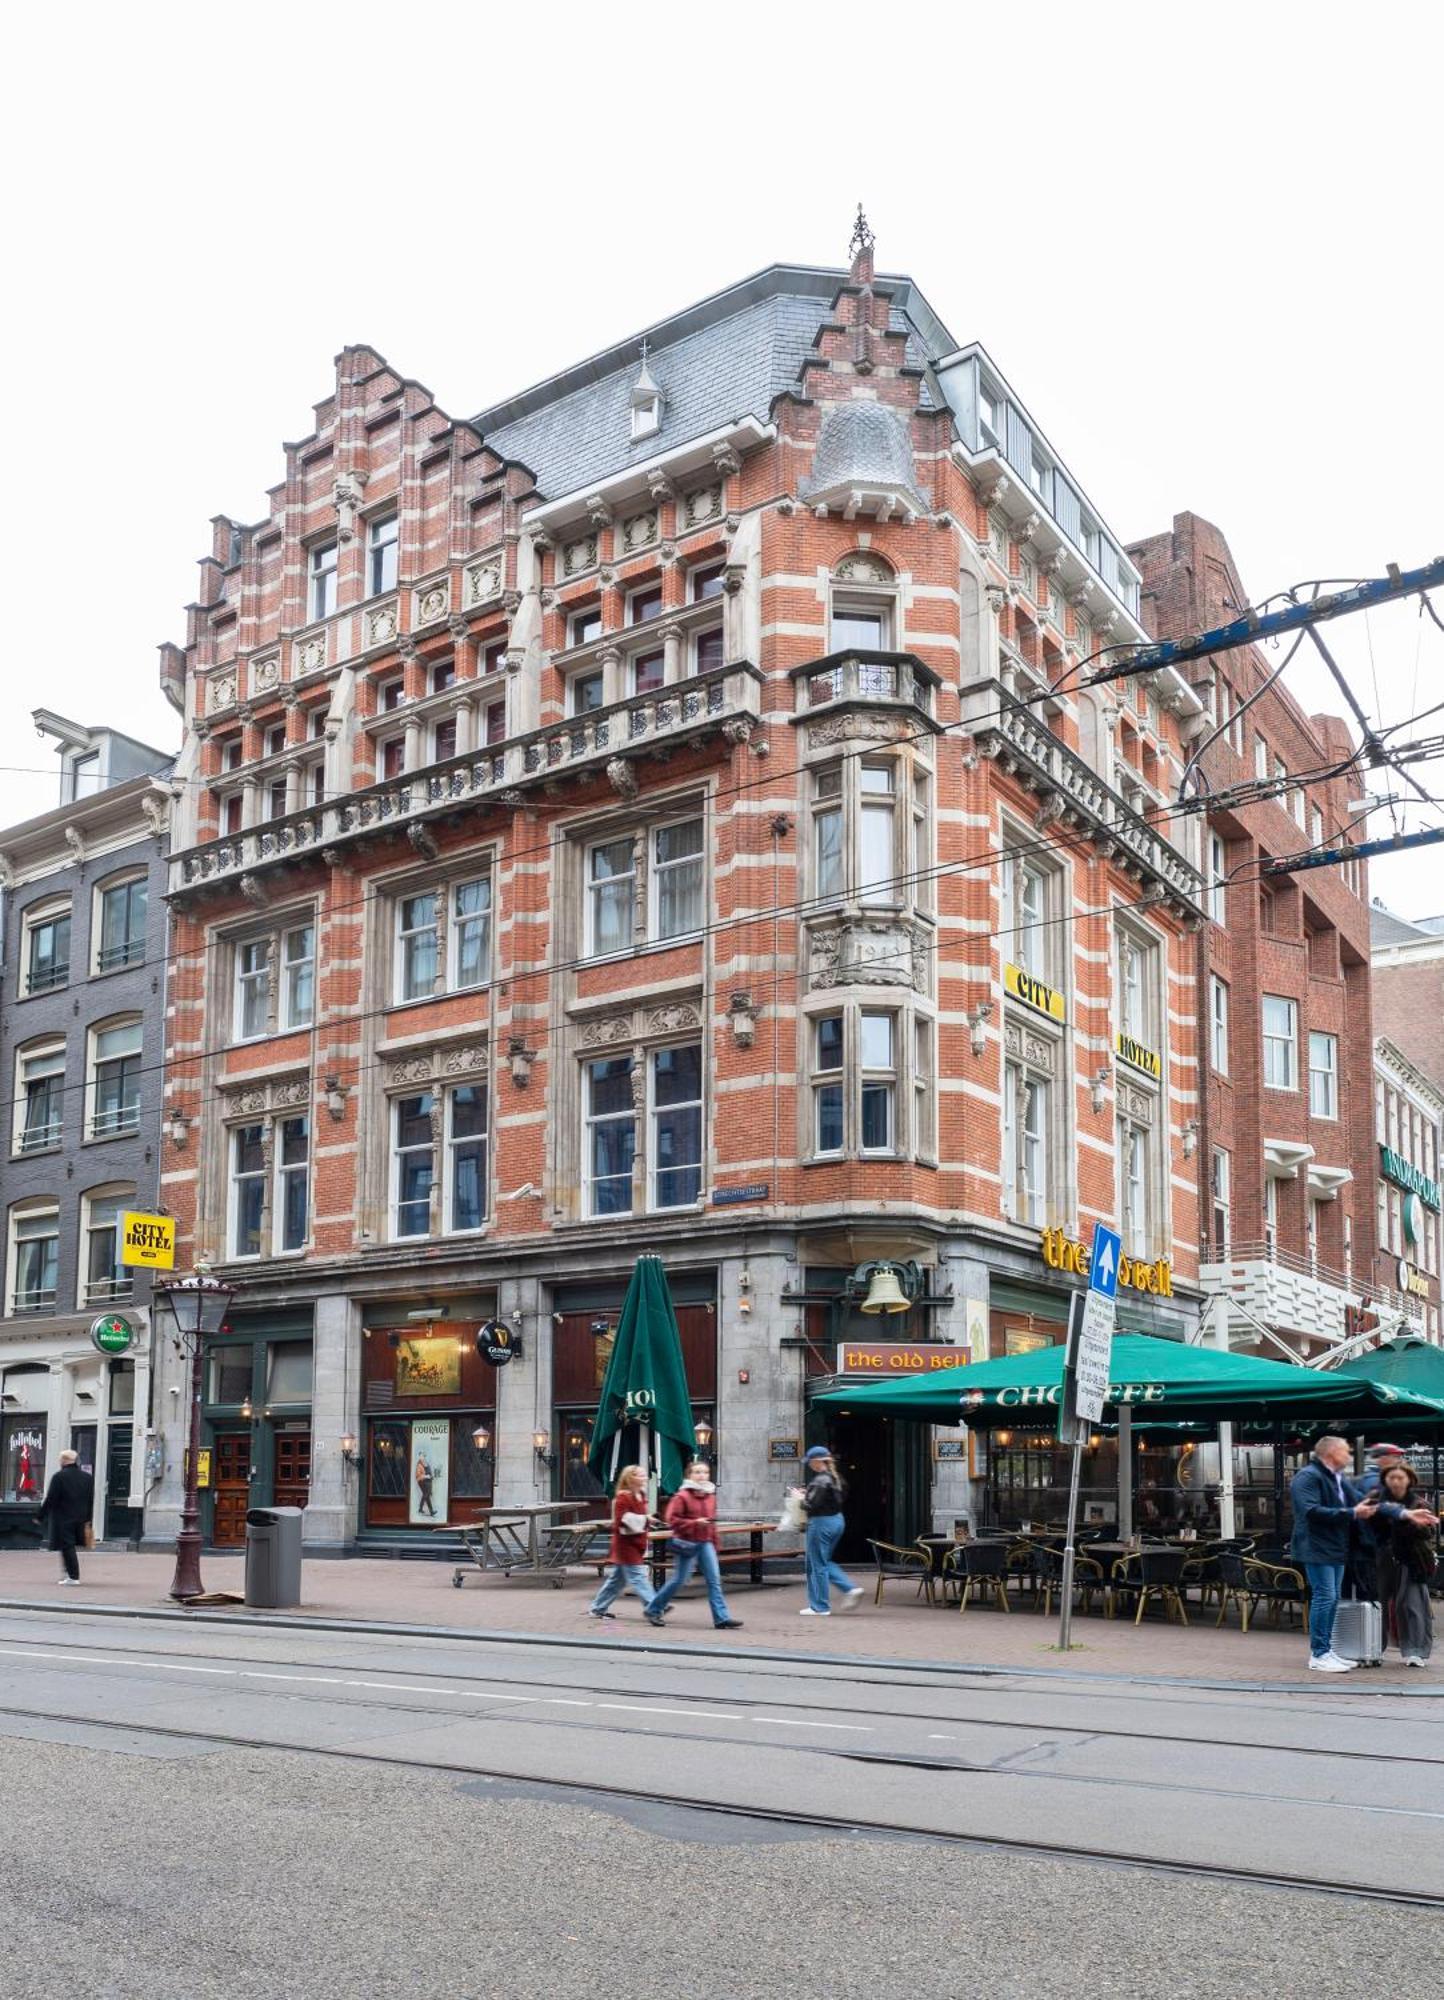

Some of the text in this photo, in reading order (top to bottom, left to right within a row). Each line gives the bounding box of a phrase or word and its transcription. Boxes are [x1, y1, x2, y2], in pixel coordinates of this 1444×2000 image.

[1016, 972, 1053, 1012] CITY
[1119, 1033, 1156, 1074] HOTEL
[132, 1223, 166, 1239] CITY
[126, 1233, 171, 1249] HOTEL
[846, 1351, 884, 1367] the
[997, 1384, 1165, 1406] CHOFFE
[414, 1425, 449, 1435] COURAGE
